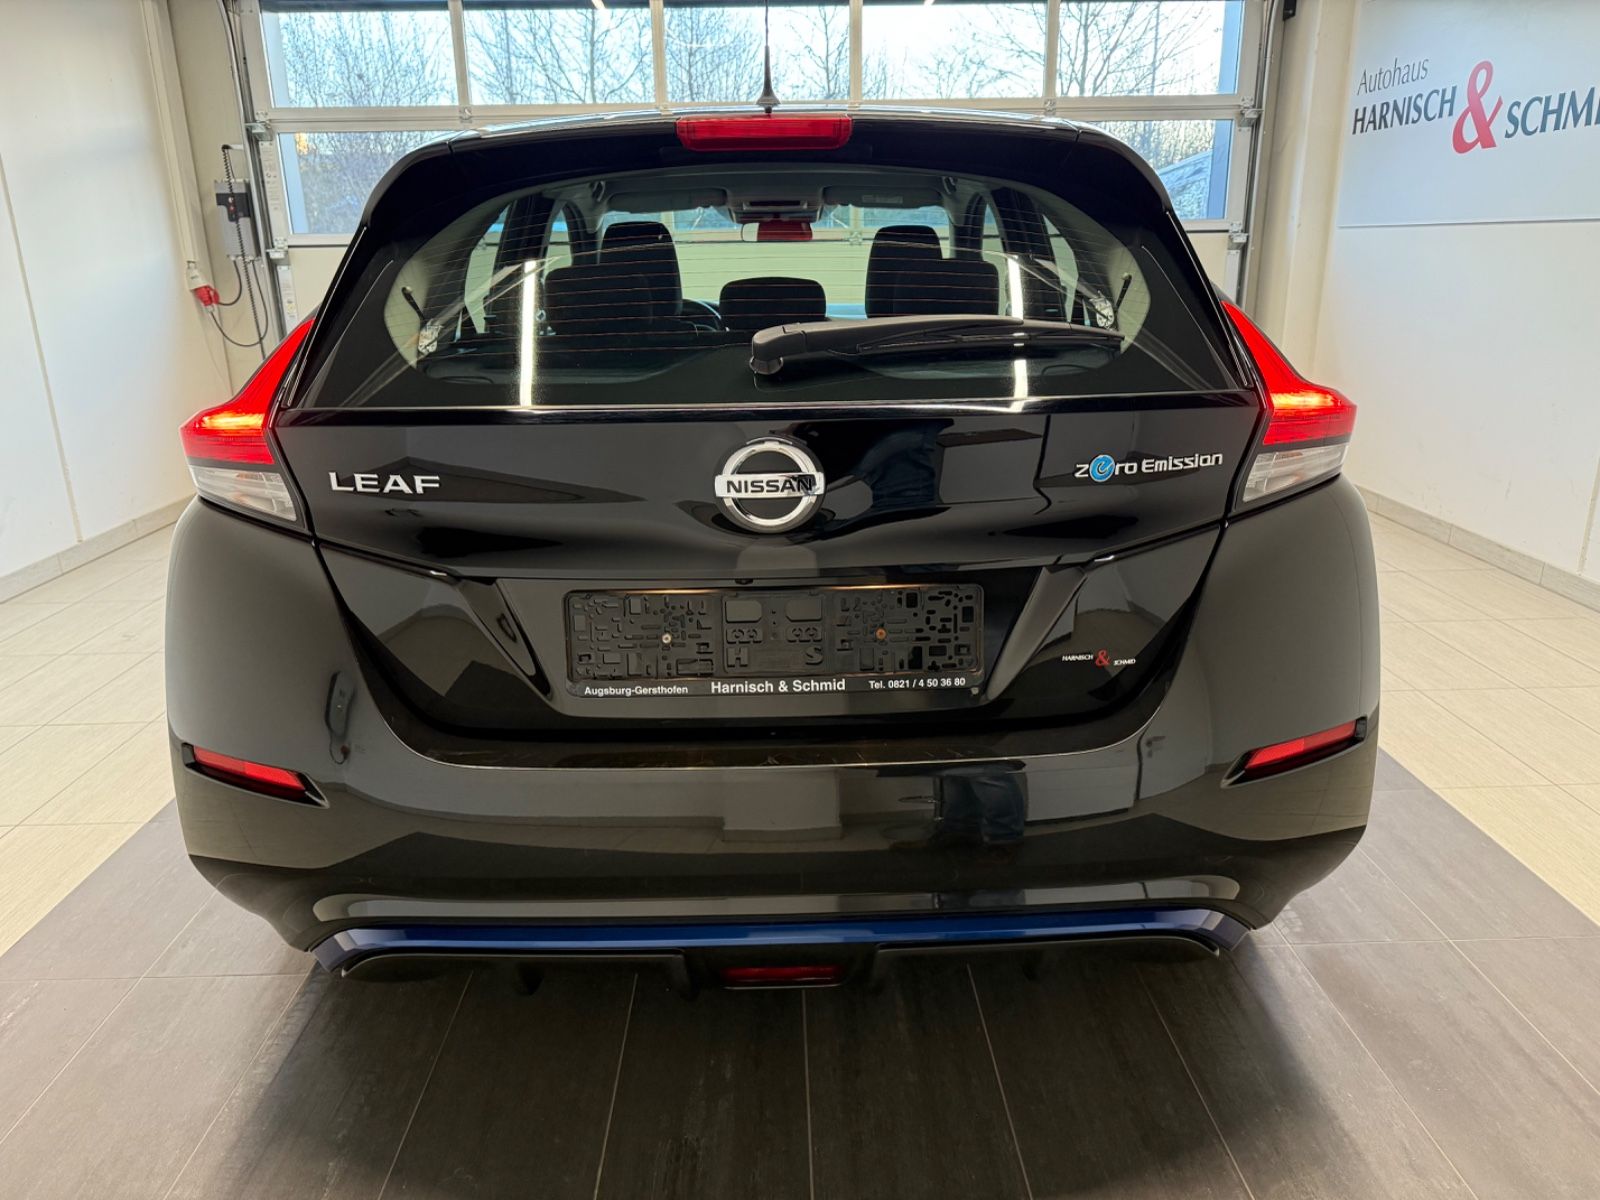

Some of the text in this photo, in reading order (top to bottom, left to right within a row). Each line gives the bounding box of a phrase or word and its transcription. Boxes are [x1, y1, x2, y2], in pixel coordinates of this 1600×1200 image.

[1356, 57, 1430, 96] Autohaus
[1352, 85, 1458, 135] HARNISCH
[1452, 60, 1503, 154] &
[1141, 453, 1223, 473] Emission
[328, 471, 440, 494] LEAF
[726, 478, 813, 494] NISSAN
[1061, 653, 1094, 662] HARNISCH
[1095, 649, 1110, 667] &
[584, 685, 689, 697] Augsburg-Gersthofen
[710, 678, 846, 694] Harnisch & Schmid
[868, 677, 966, 690] Tel. 0821 / 4 50 36 80
